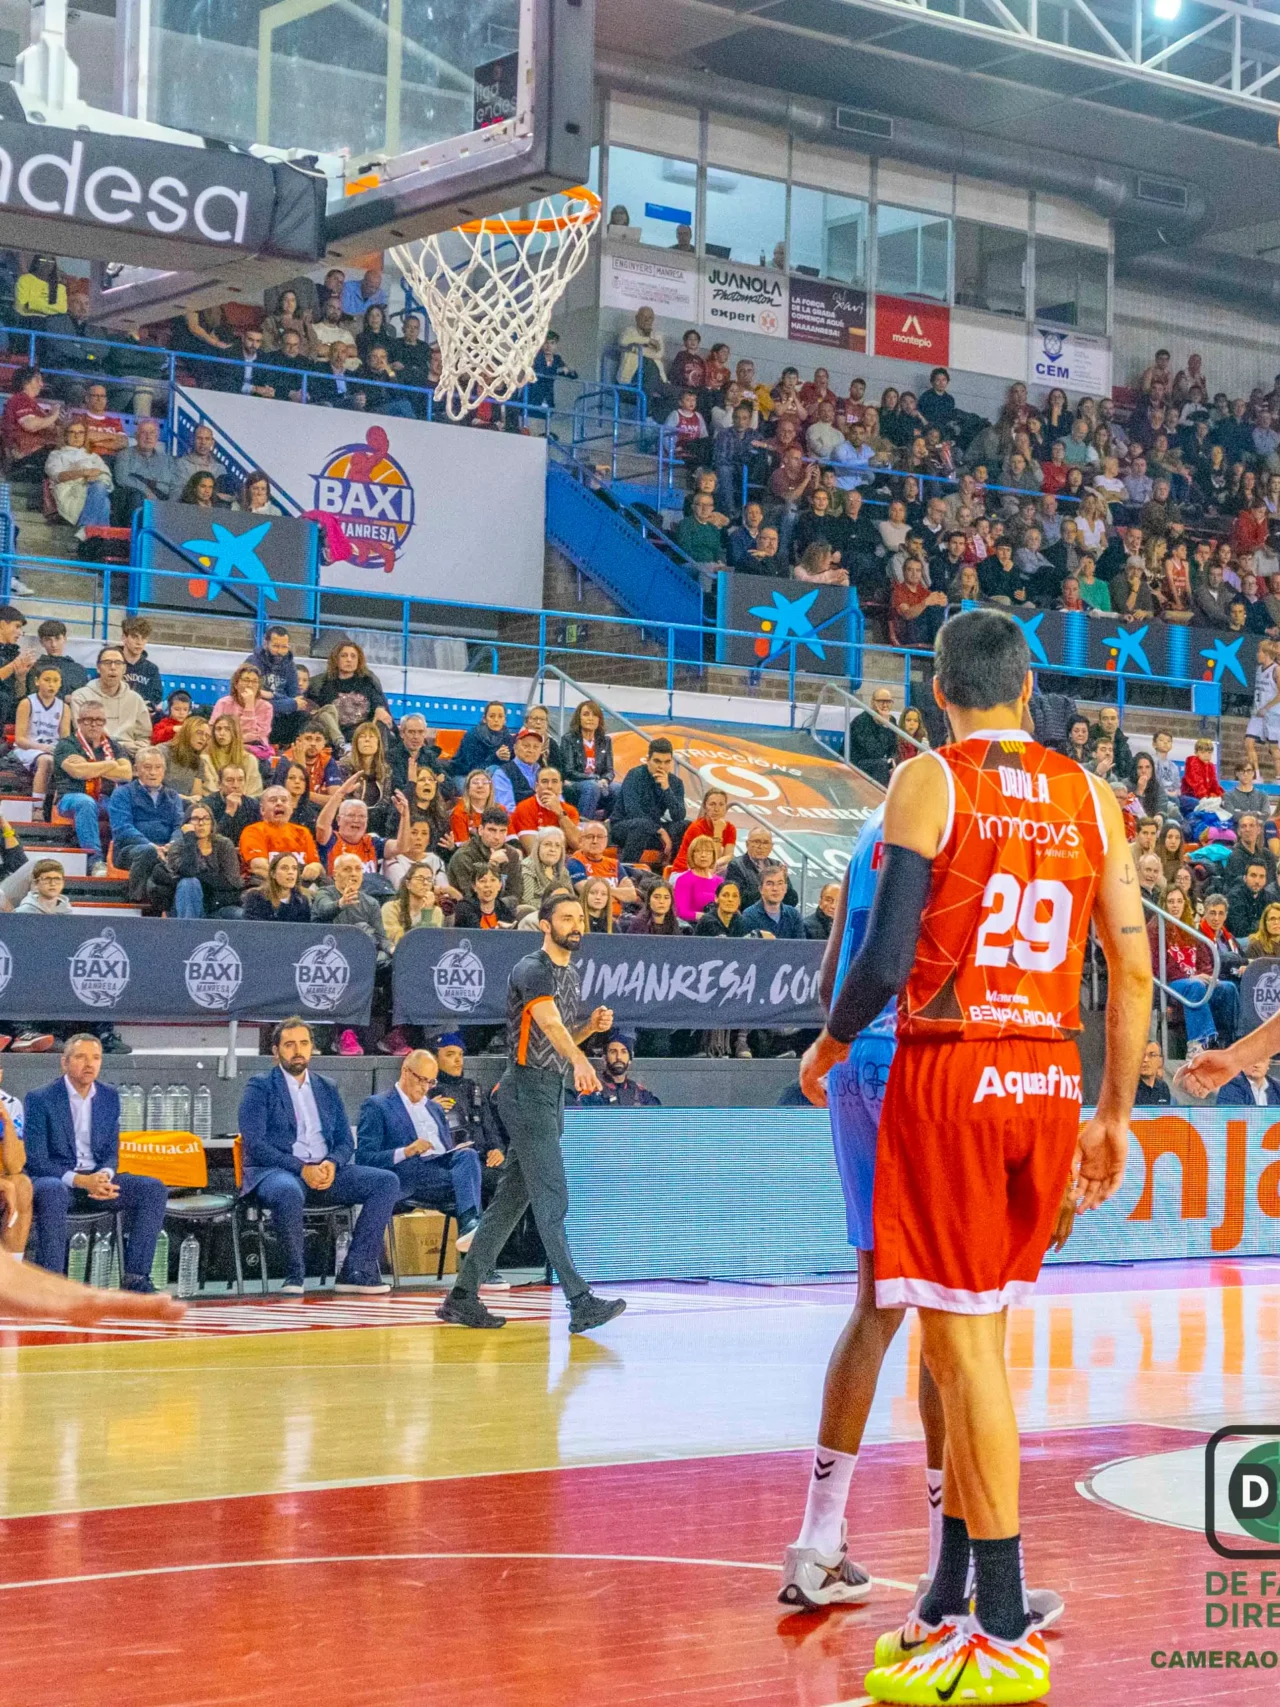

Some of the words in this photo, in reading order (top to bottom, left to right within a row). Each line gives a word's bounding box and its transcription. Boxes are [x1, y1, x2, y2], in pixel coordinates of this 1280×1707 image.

[709, 269, 782, 297] JUANOLA
[711, 307, 756, 324] expert
[1036, 363, 1070, 379] CEM
[319, 478, 412, 522] BAXI
[974, 872, 1074, 973] 29
[73, 960, 128, 979] BAXI
[189, 961, 241, 982] BAXI
[299, 964, 349, 984] BAXI
[437, 968, 483, 988] BAXI
[81, 981, 117, 992] MANRESA
[196, 983, 230, 994] MANRESA
[576, 957, 821, 1007] IMANRESA.CO
[969, 1004, 1062, 1028] BENPARIDA!
[120, 1140, 201, 1155] mutuacat
